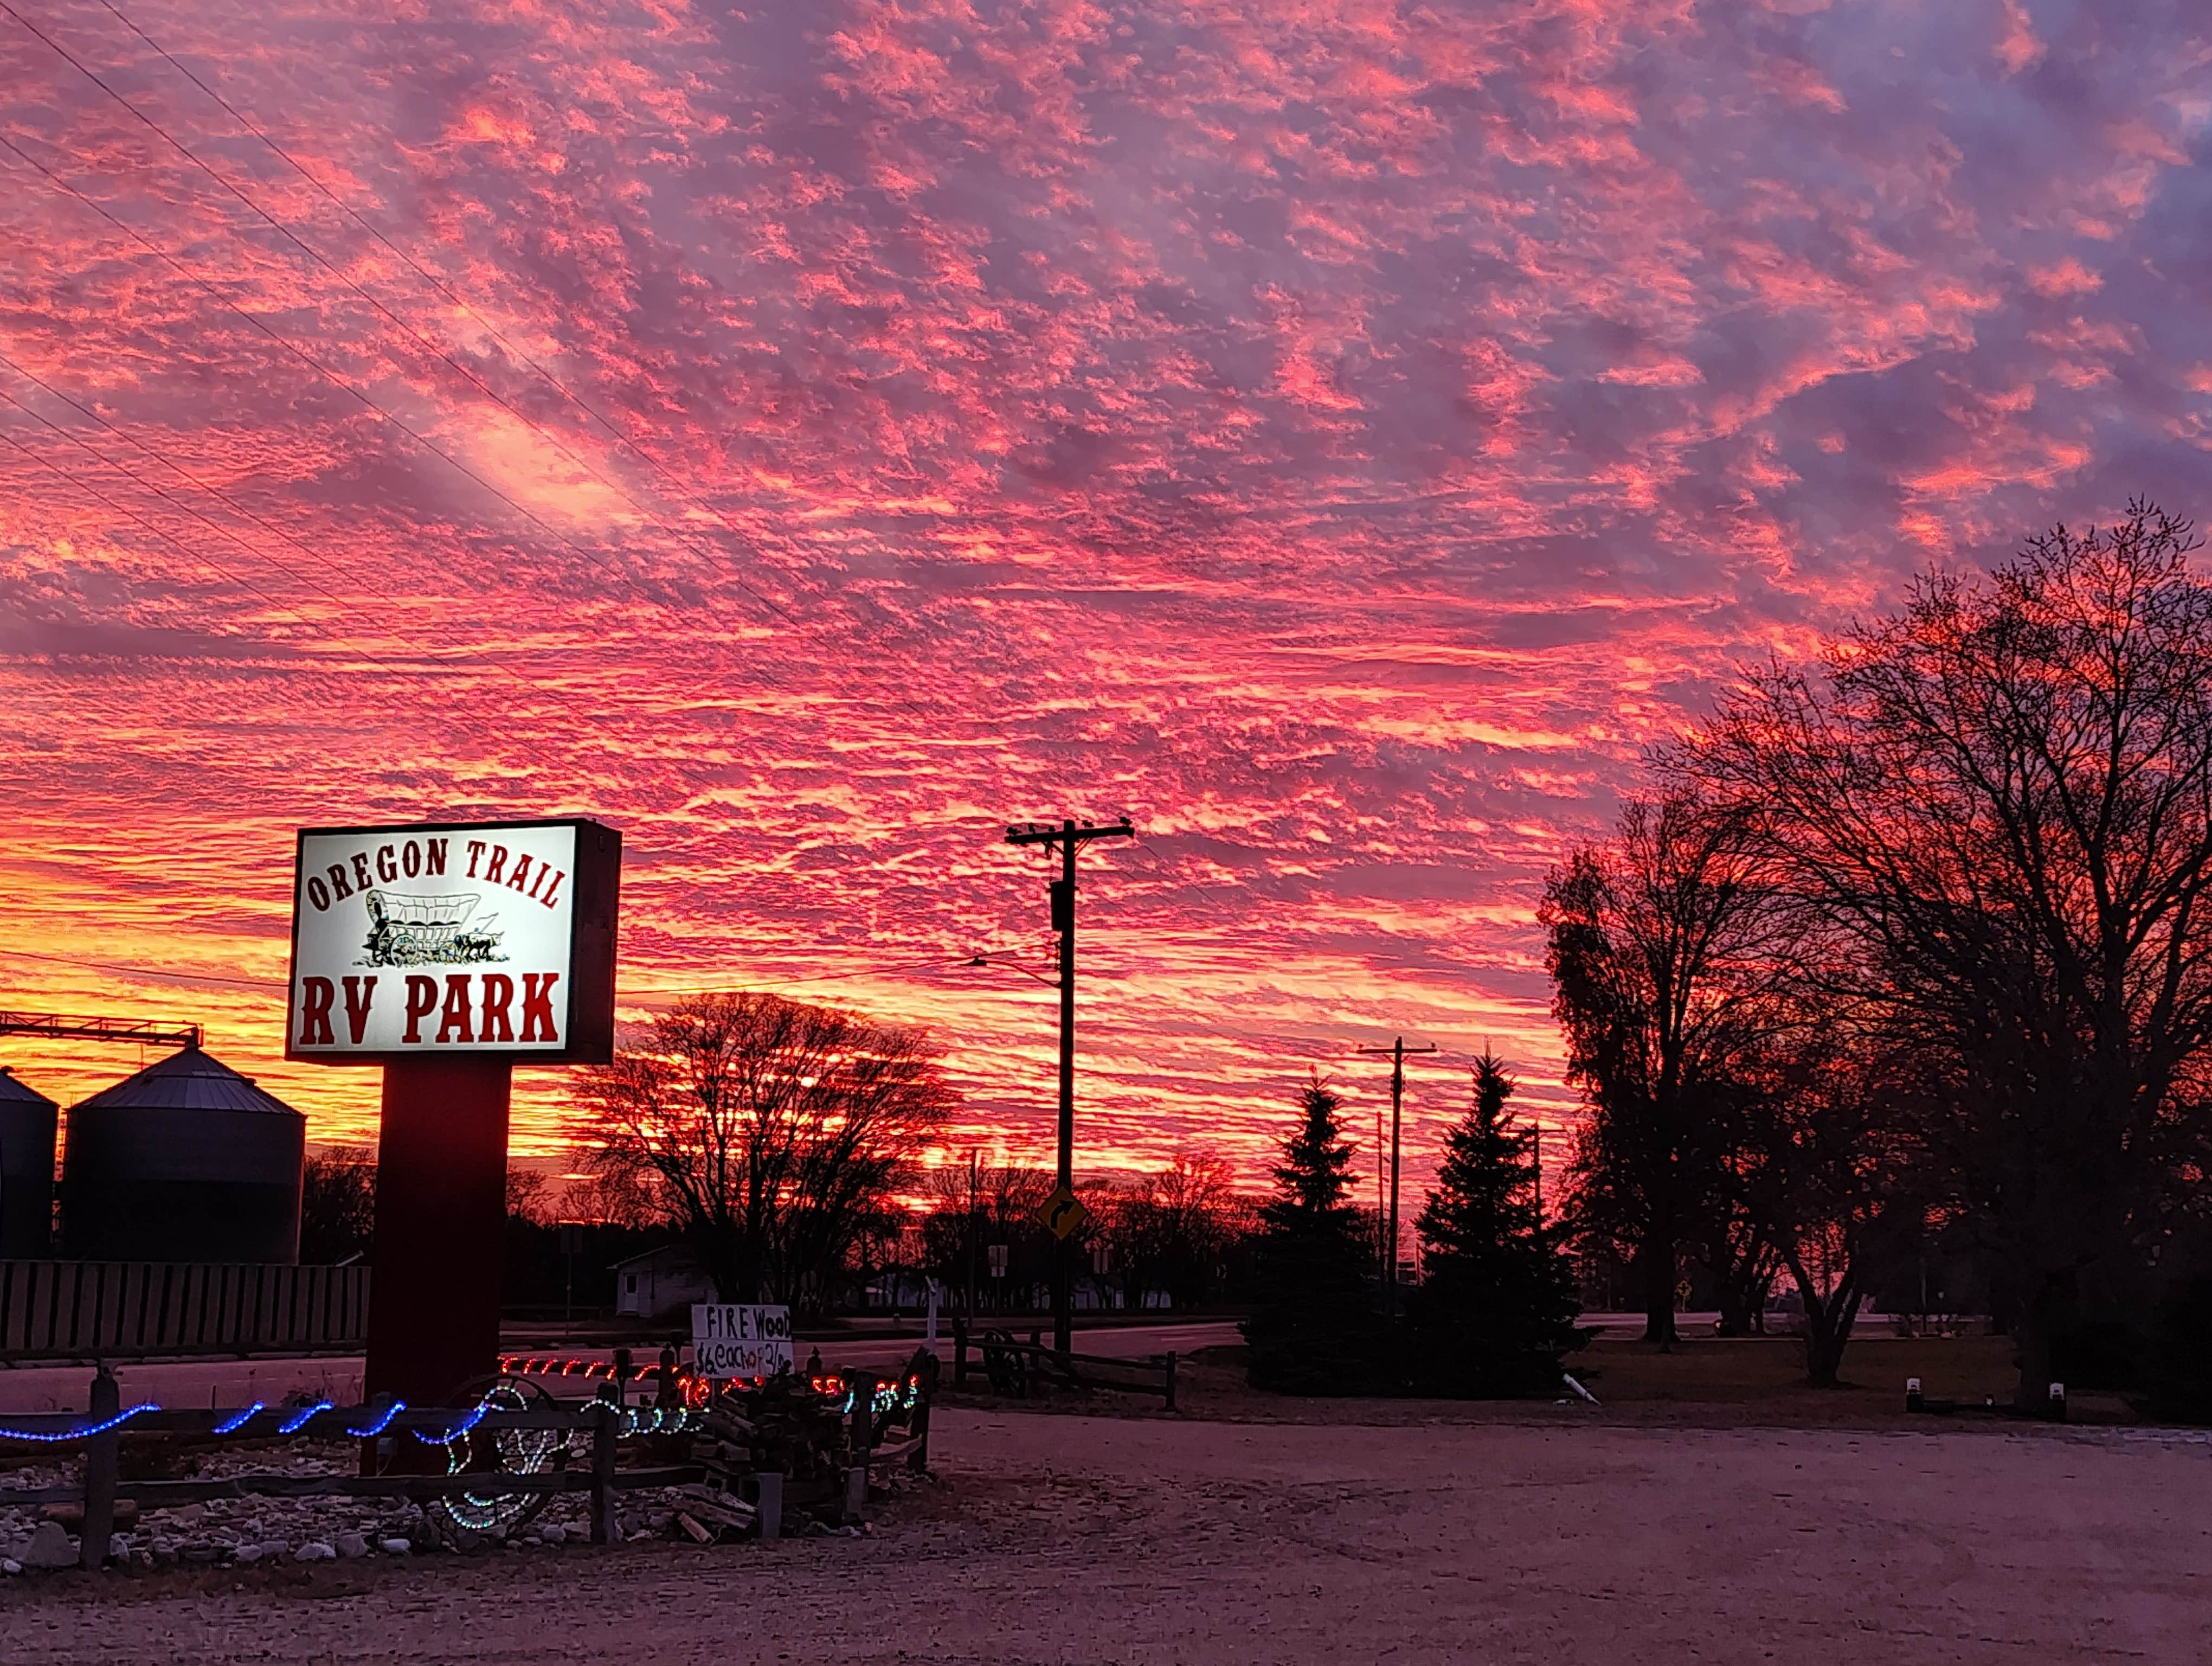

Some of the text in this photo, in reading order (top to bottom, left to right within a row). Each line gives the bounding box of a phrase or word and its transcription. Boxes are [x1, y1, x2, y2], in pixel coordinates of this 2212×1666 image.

[307, 838, 567, 912] OREGON TRAIL
[299, 973, 560, 1045] RV PARK
